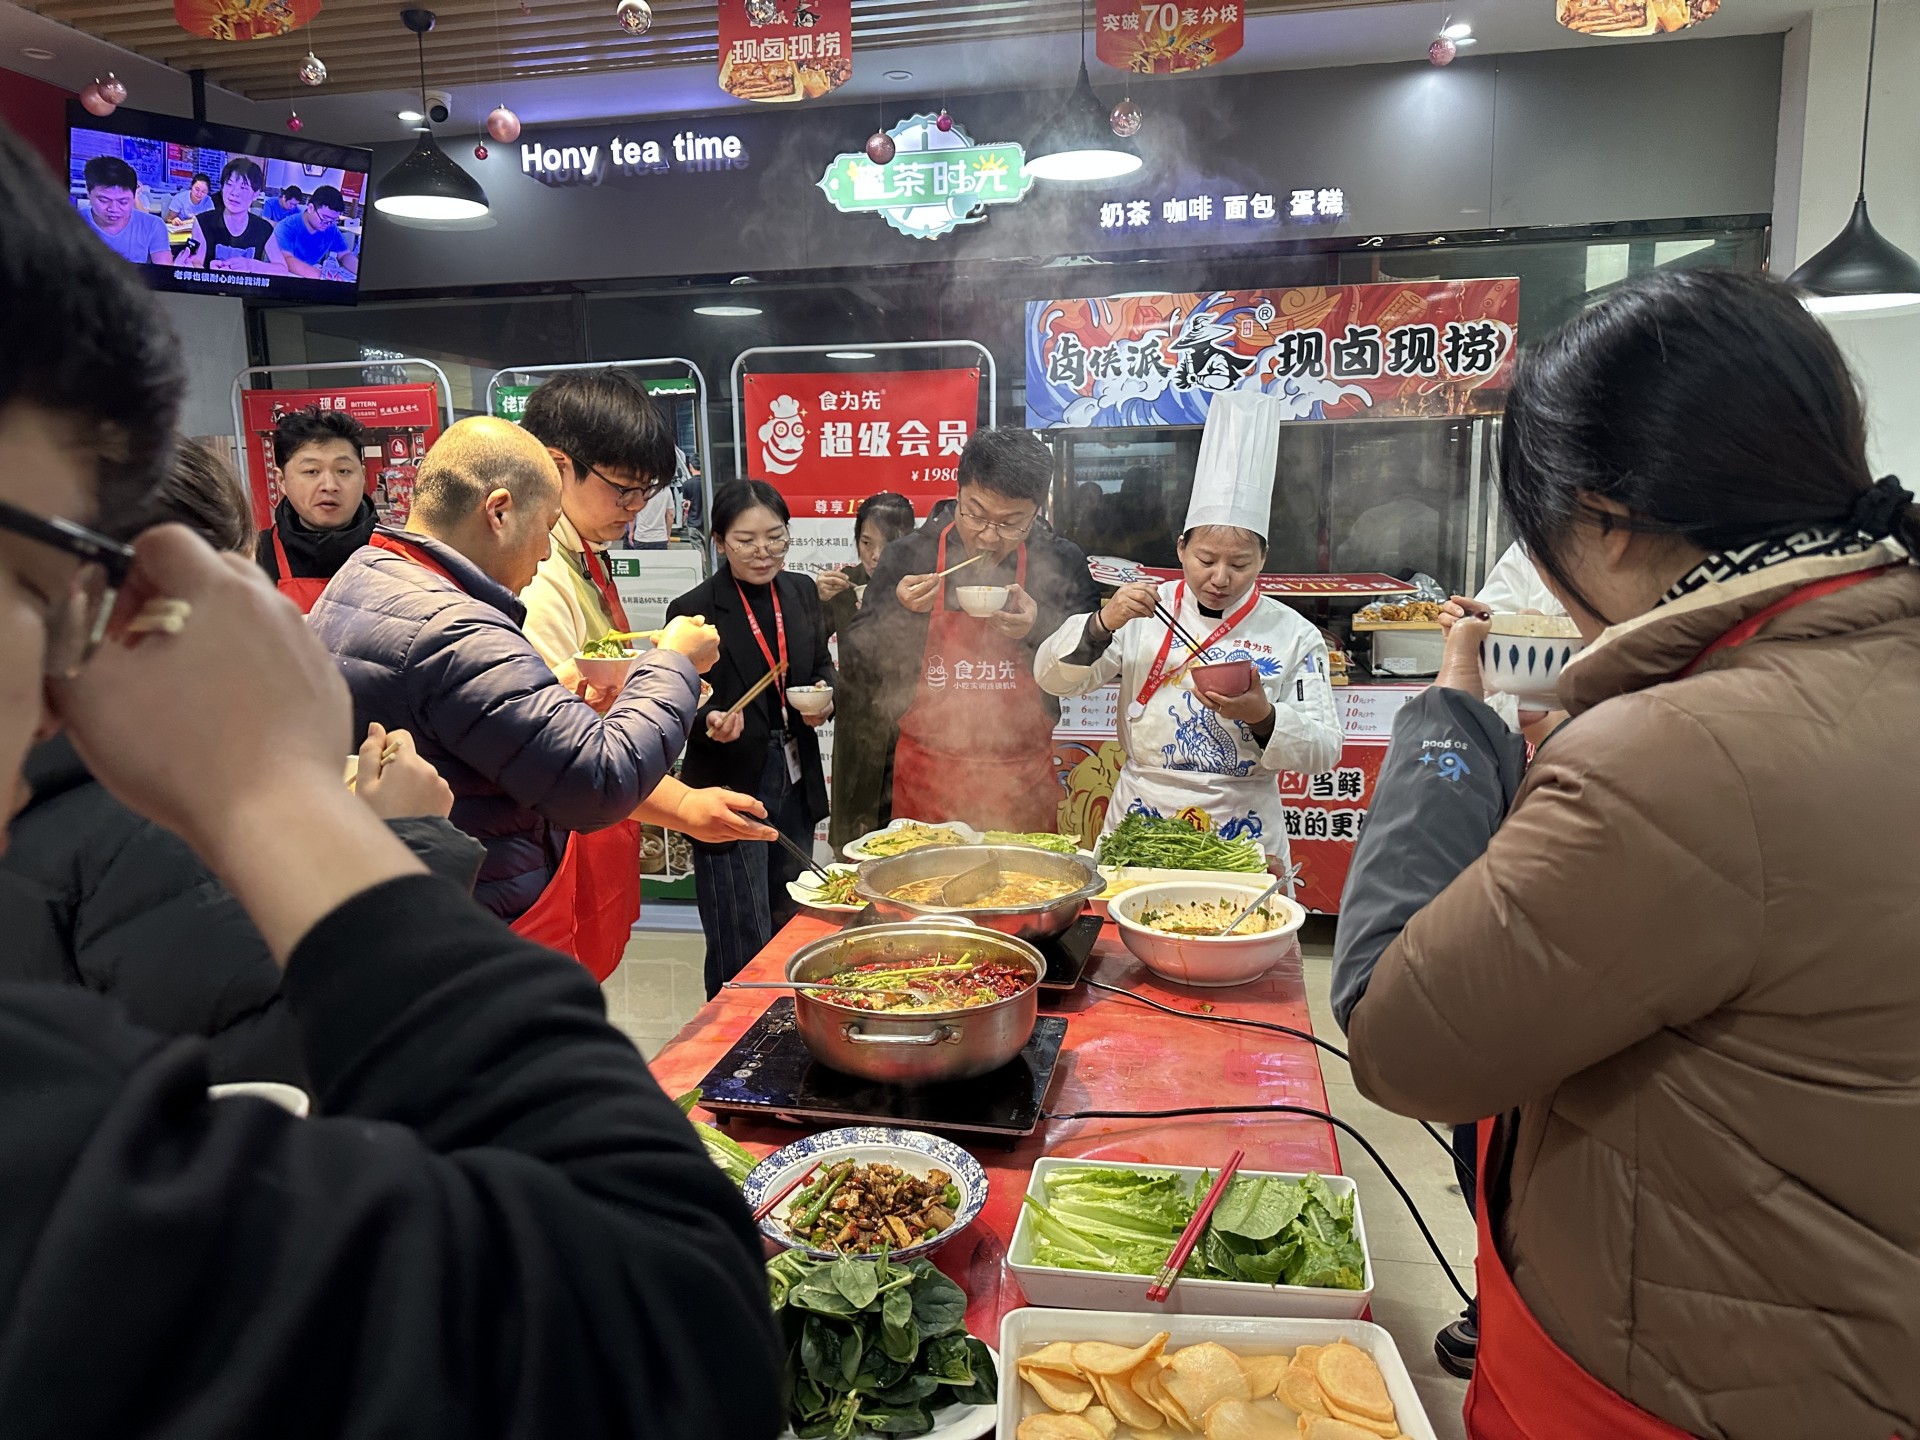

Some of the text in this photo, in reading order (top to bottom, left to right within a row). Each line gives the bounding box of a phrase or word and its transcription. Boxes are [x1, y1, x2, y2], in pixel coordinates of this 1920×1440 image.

[1102, 3, 1238, 33] 突破70家分校
[732, 31, 842, 64] 现卤现捞
[520, 131, 742, 176] Hony tea time
[1099, 188, 1343, 228] 奶茶 咖啡 面包 蛋糕
[1049, 336, 1170, 387] 卤侠派
[1276, 323, 1496, 379] 现卤现捞
[319, 397, 346, 410] 现卤
[818, 390, 881, 411] 食为先
[819, 419, 968, 458] 超级会员
[953, 659, 1015, 680] 食为先
[1421, 739, 1468, 750] so good
